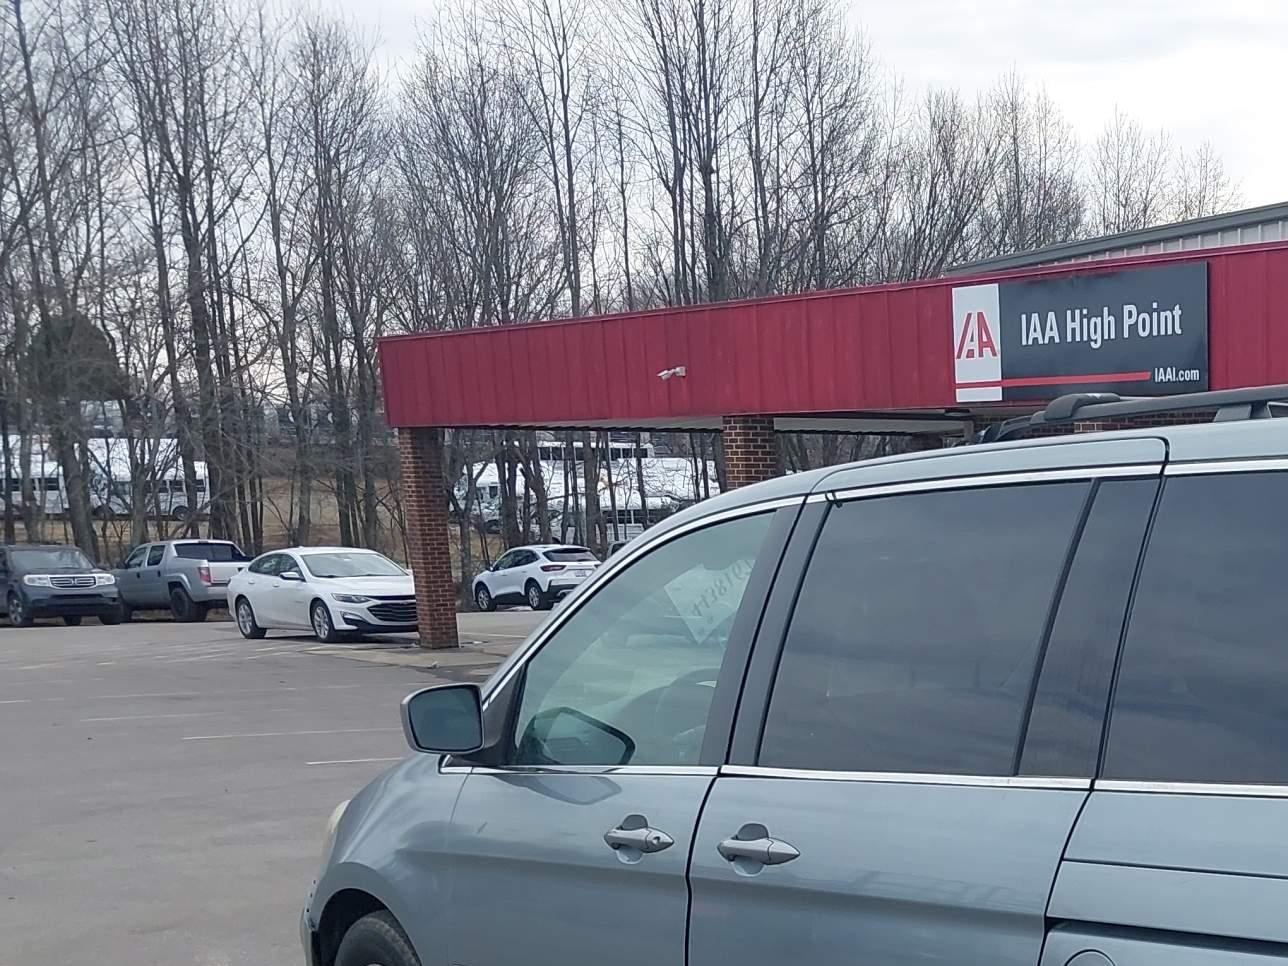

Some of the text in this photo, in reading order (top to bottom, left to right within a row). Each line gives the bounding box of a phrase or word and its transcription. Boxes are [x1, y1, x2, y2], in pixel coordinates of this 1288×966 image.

[1021, 302, 1183, 349] IAA High Point
[1154, 366, 1200, 383] IAAI.com
